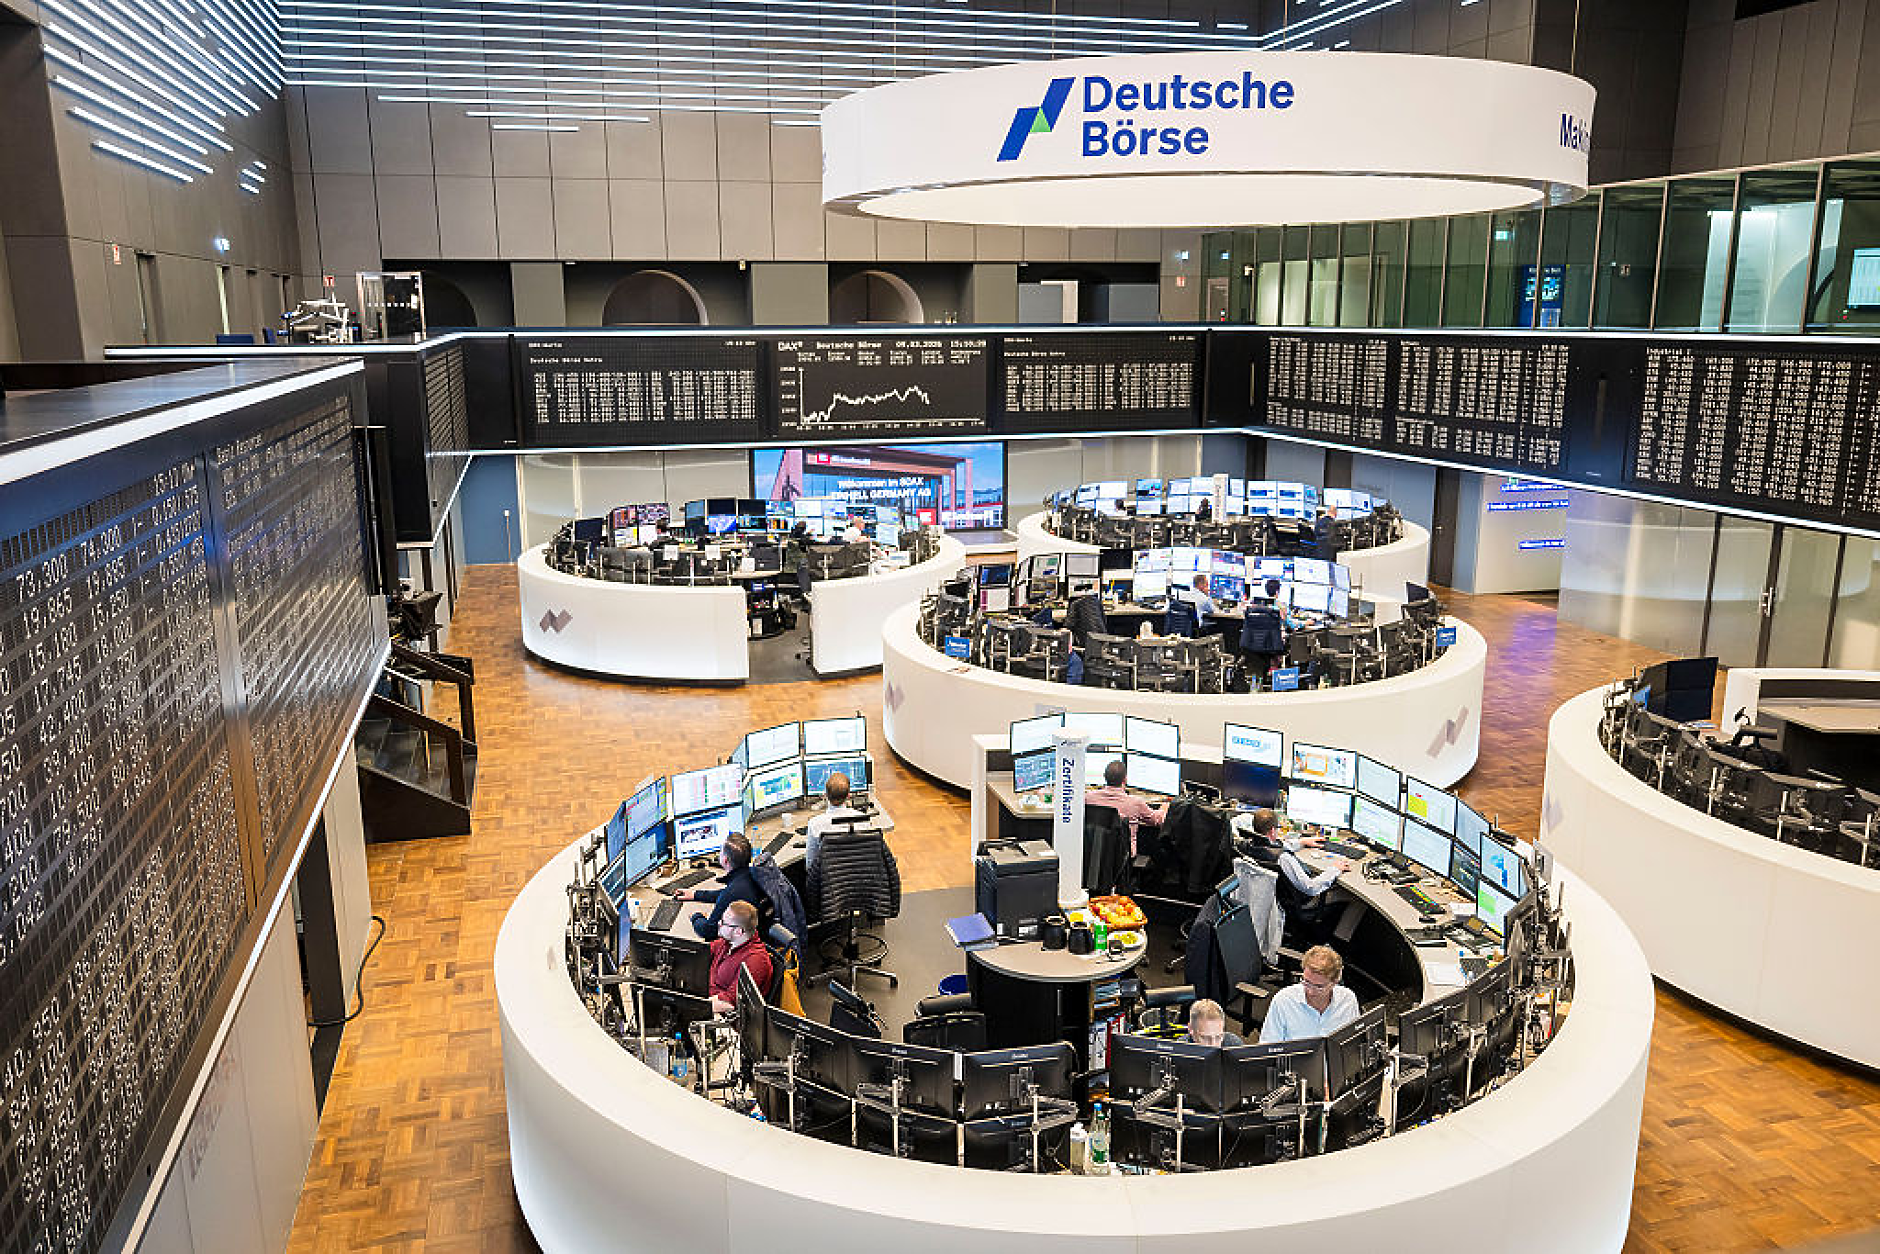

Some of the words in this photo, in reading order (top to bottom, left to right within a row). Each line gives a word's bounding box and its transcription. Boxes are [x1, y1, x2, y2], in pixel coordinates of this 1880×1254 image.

[1083, 71, 1295, 113] Deutsche
[1082, 119, 1209, 157] Börse
[15, 551, 68, 605] 73,300
[21, 585, 73, 642] 19,865
[1062, 757, 1075, 824] Zertifikate
